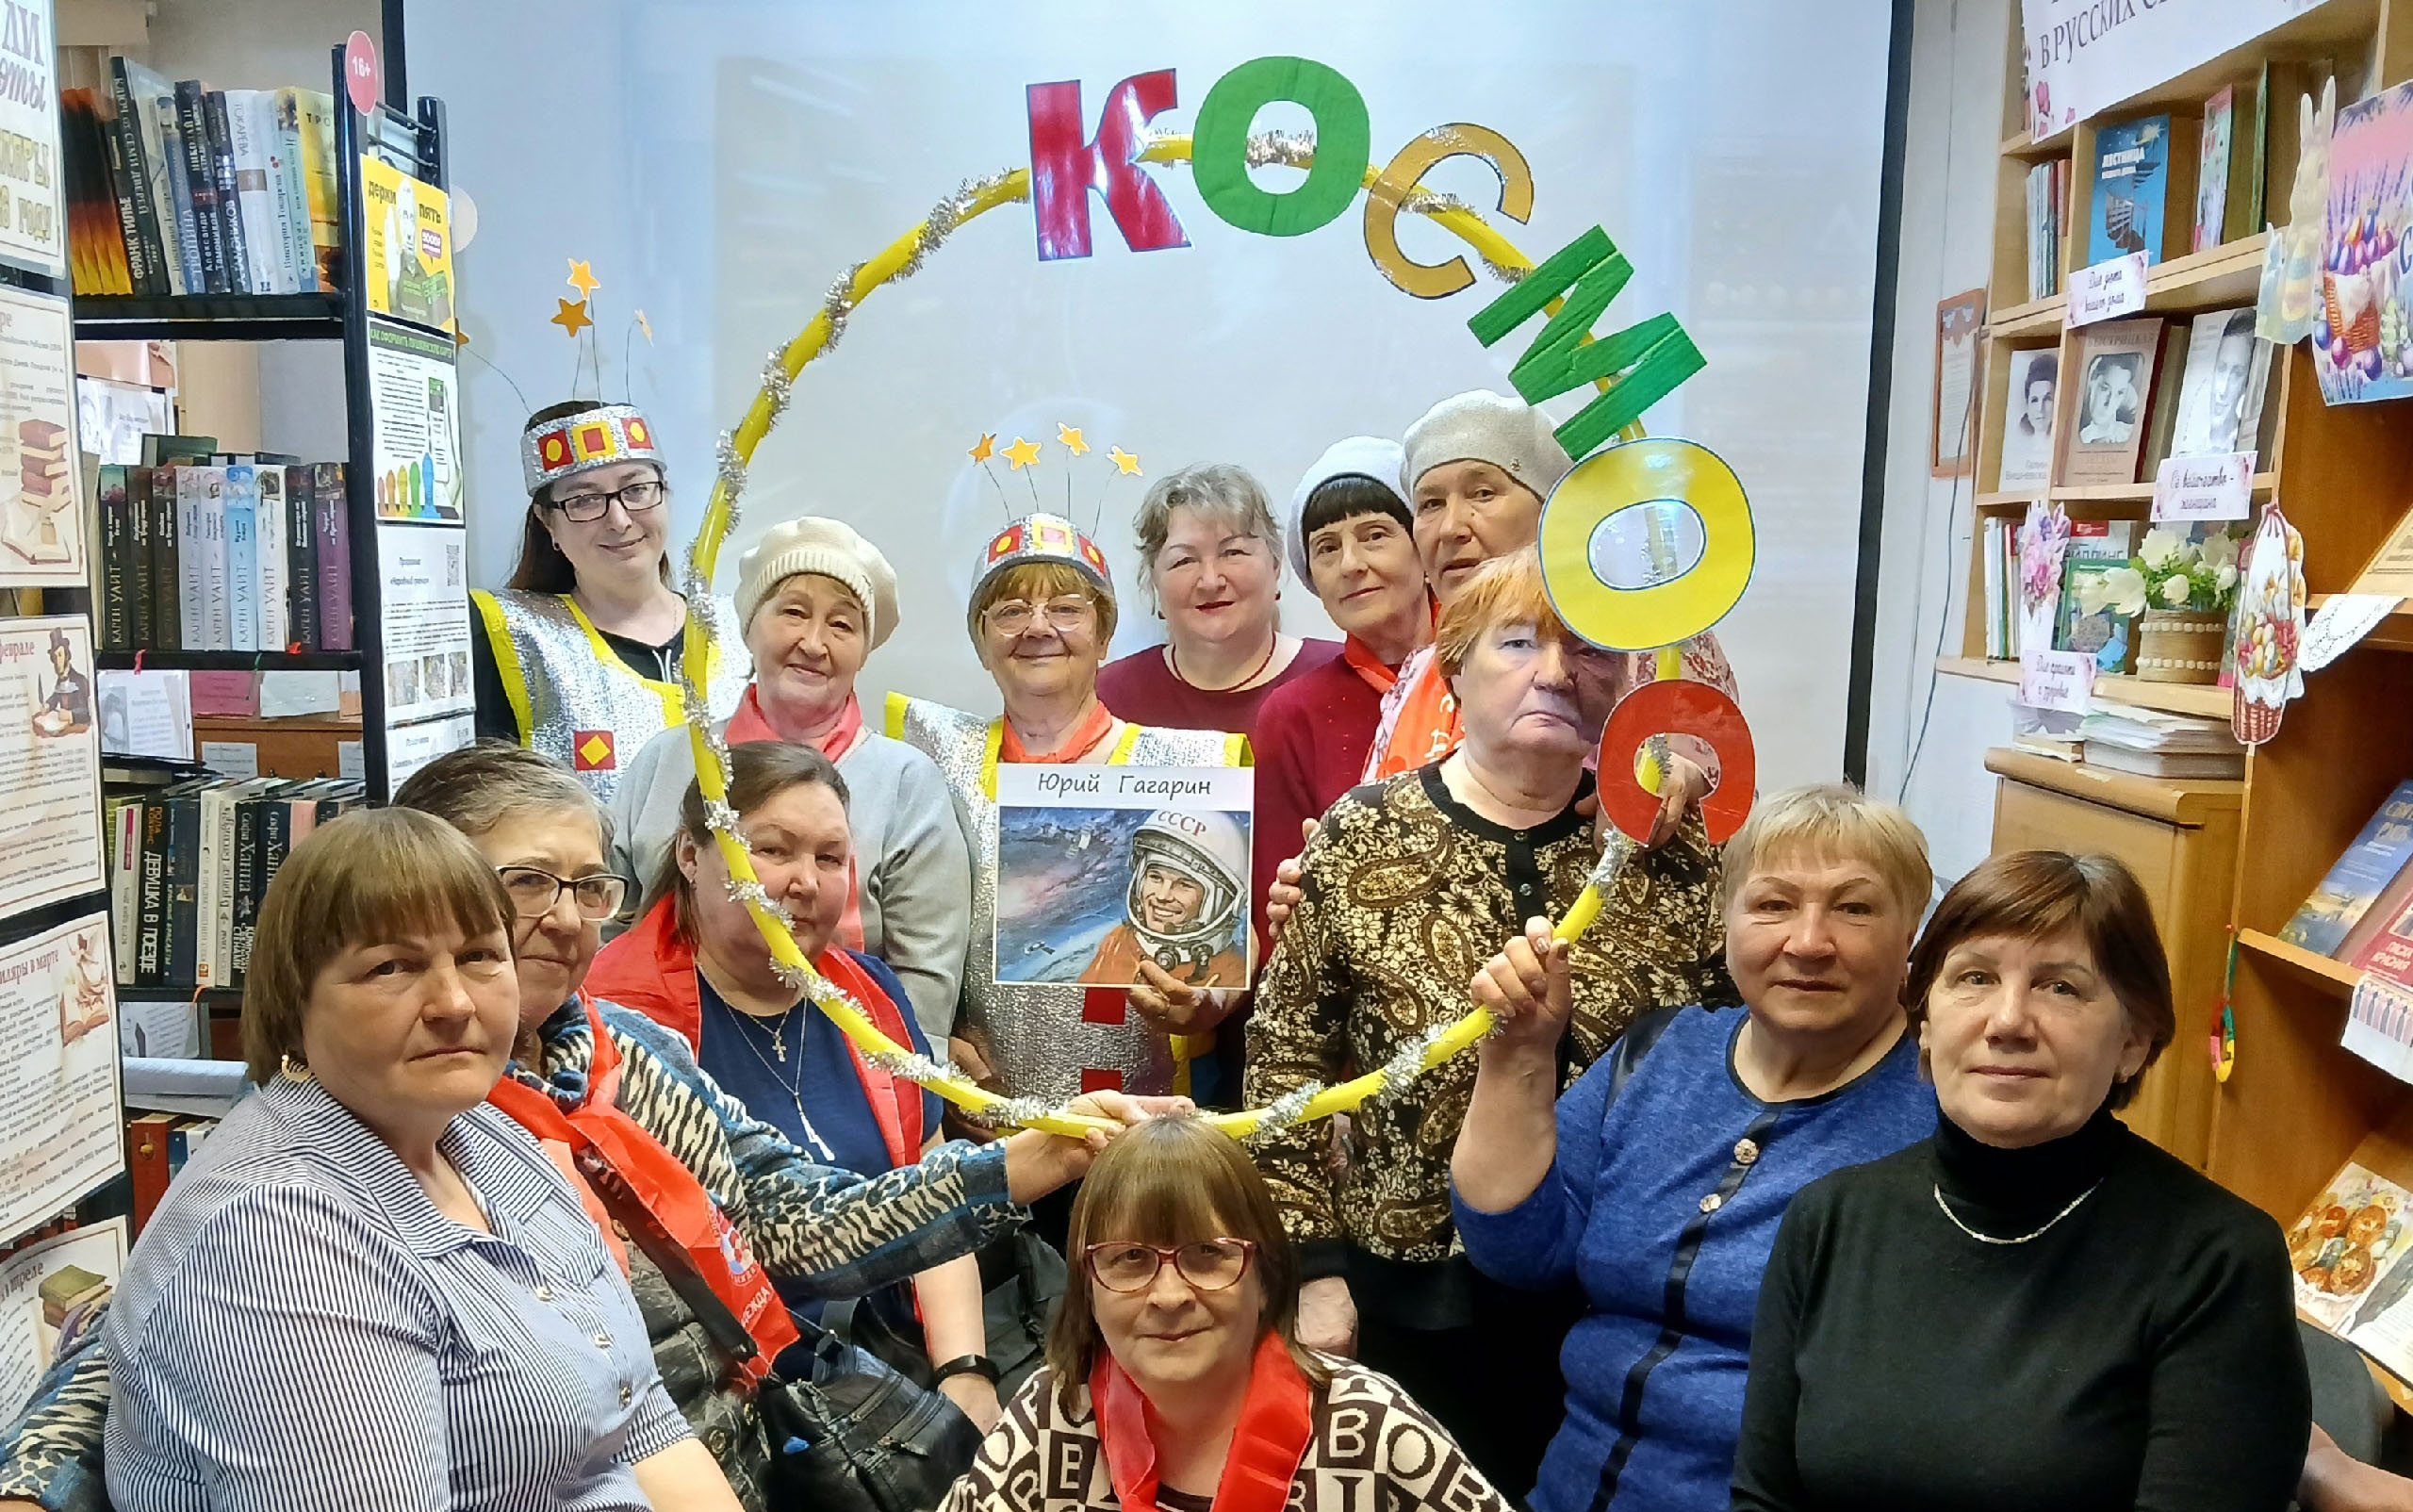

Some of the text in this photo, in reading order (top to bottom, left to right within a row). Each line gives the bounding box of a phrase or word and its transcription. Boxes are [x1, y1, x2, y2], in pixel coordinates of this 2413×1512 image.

[2041, 0, 2136, 70] В РУССКИХ
[353, 57, 370, 77] 16+
[235, 104, 250, 156] ТОКАРЕВА
[369, 180, 441, 223] держи пять
[120, 196, 144, 280] ФРАНК ТИЛЬЕ
[199, 212, 213, 271] Александр
[1026, 55, 1757, 846] КОСМОС
[108, 565, 123, 603] УАЙТ
[236, 565, 249, 603] УАЙТ
[1038, 773, 1211, 800] Юрий Гагарин
[1157, 810, 1206, 838] СССР
[239, 812, 255, 892] Софи Ханна
[140, 850, 162, 974] ДЕВУШКА В ПОЕЗДЕ
